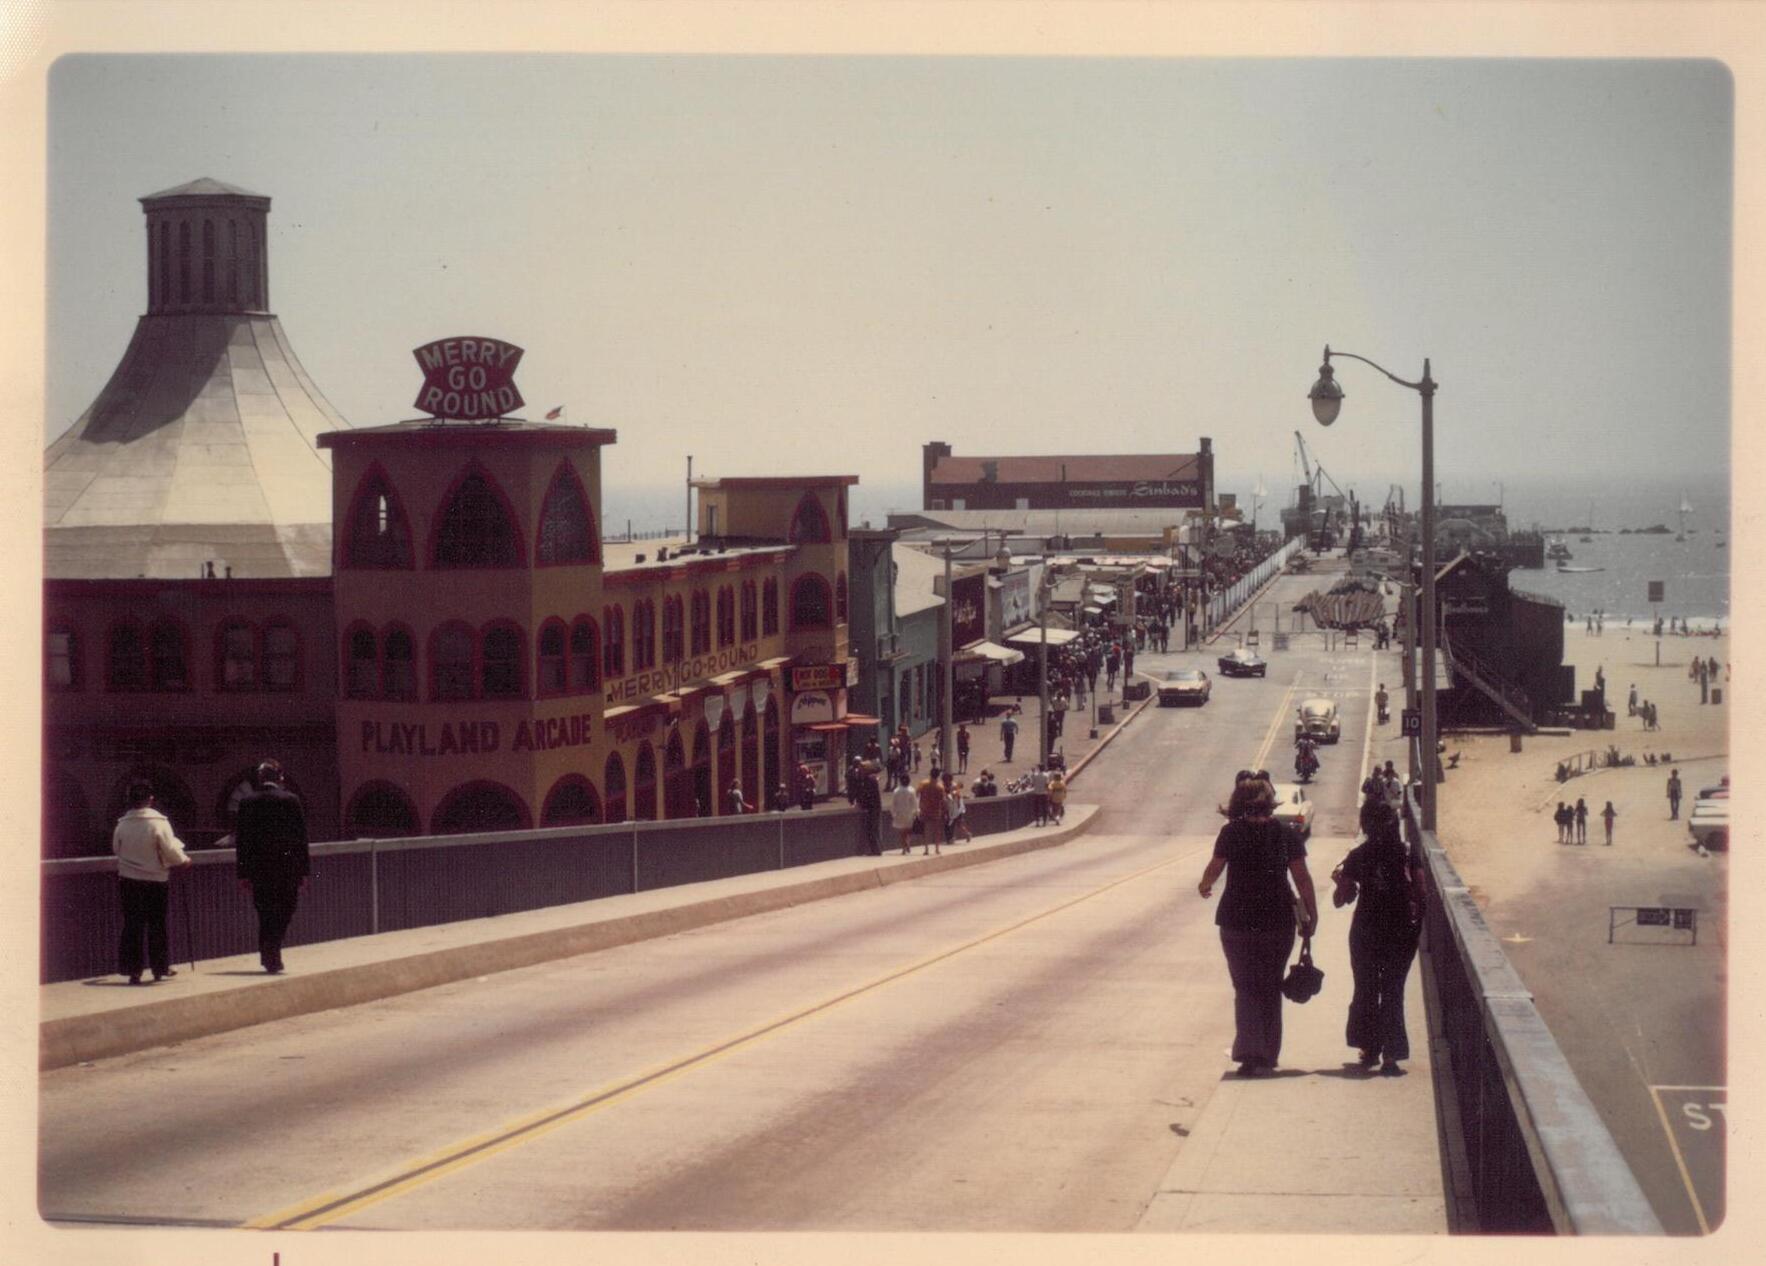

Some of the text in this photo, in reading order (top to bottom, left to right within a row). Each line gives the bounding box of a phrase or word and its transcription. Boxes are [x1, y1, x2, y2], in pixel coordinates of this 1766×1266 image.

[421, 340, 516, 370] MERRY
[448, 366, 487, 391] GO
[423, 386, 515, 417] ROUND
[361, 720, 500, 756] PLAYLAND
[512, 714, 592, 752] ARCADE
[1405, 716, 1420, 729] 10
